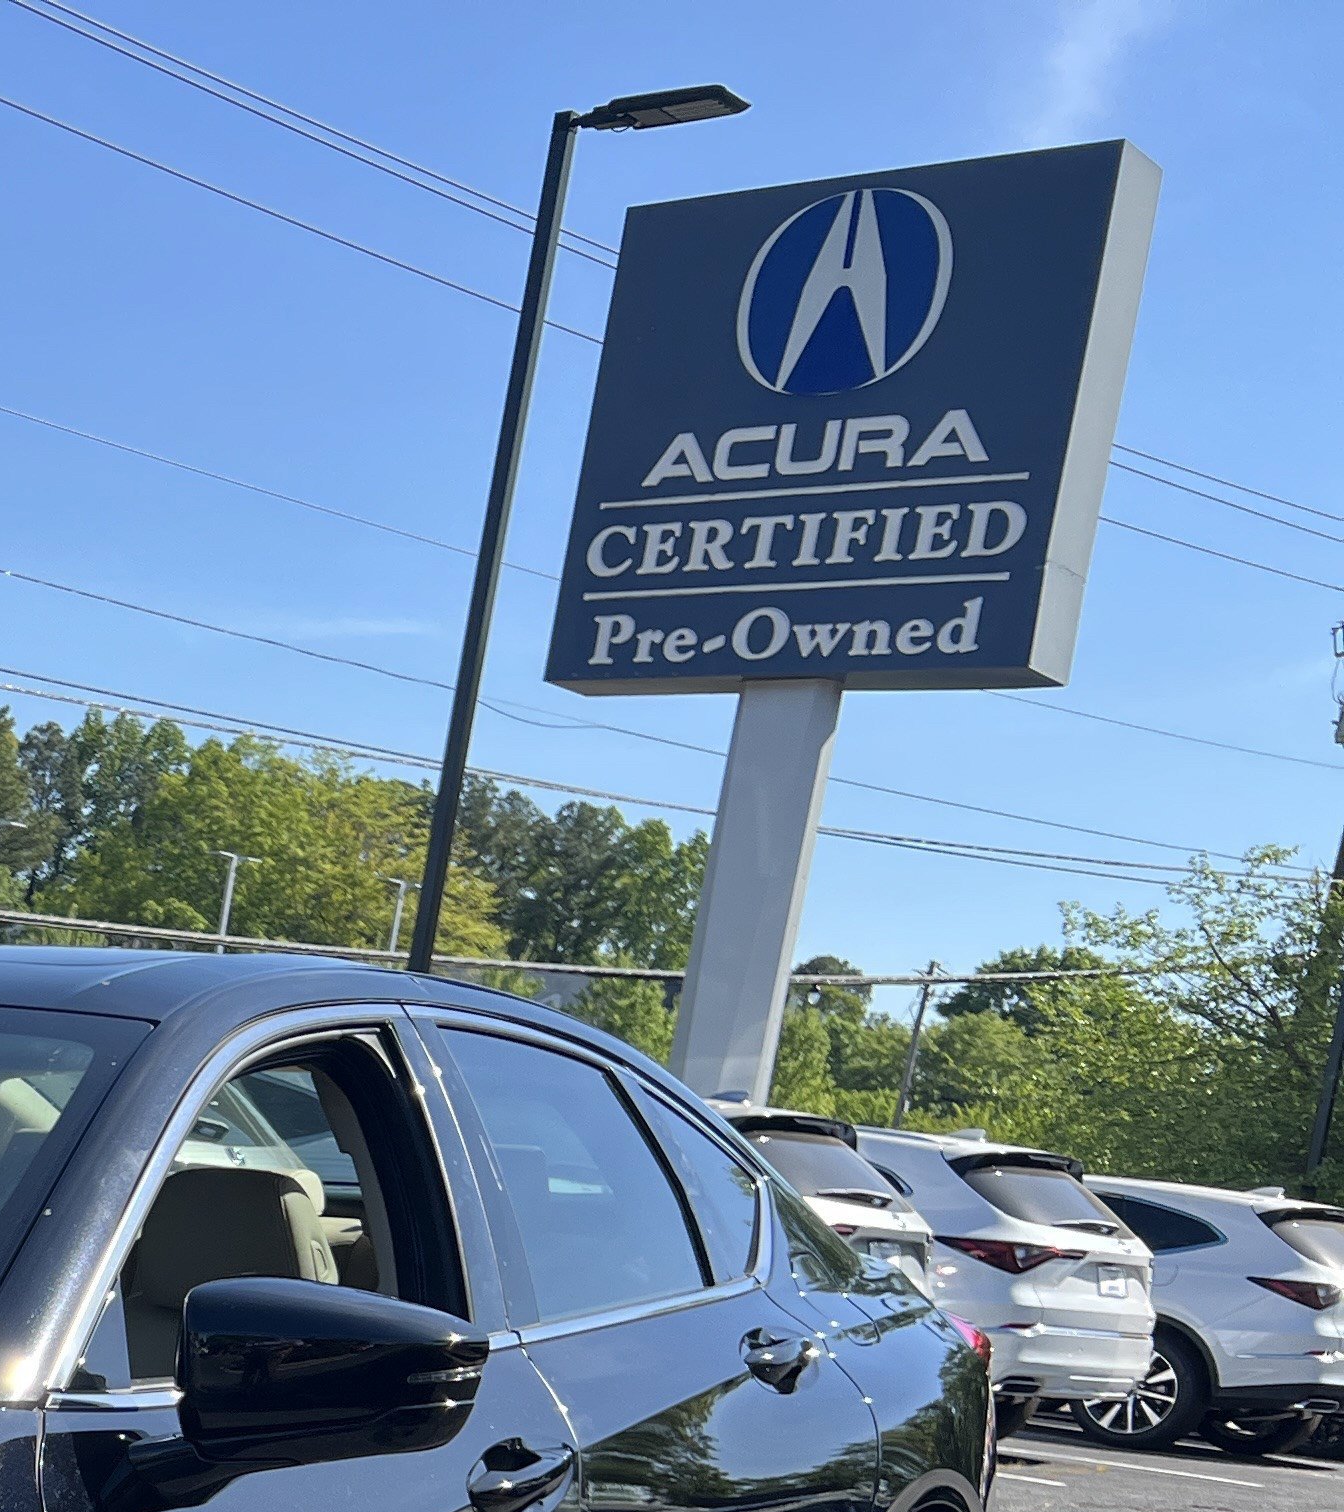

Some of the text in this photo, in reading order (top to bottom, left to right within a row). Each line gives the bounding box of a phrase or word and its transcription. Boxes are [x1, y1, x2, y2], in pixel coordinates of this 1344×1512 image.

[641, 409, 990, 488] ACURA
[585, 500, 1029, 578] CERTIFIED
[587, 596, 985, 666] Pre-Owned
